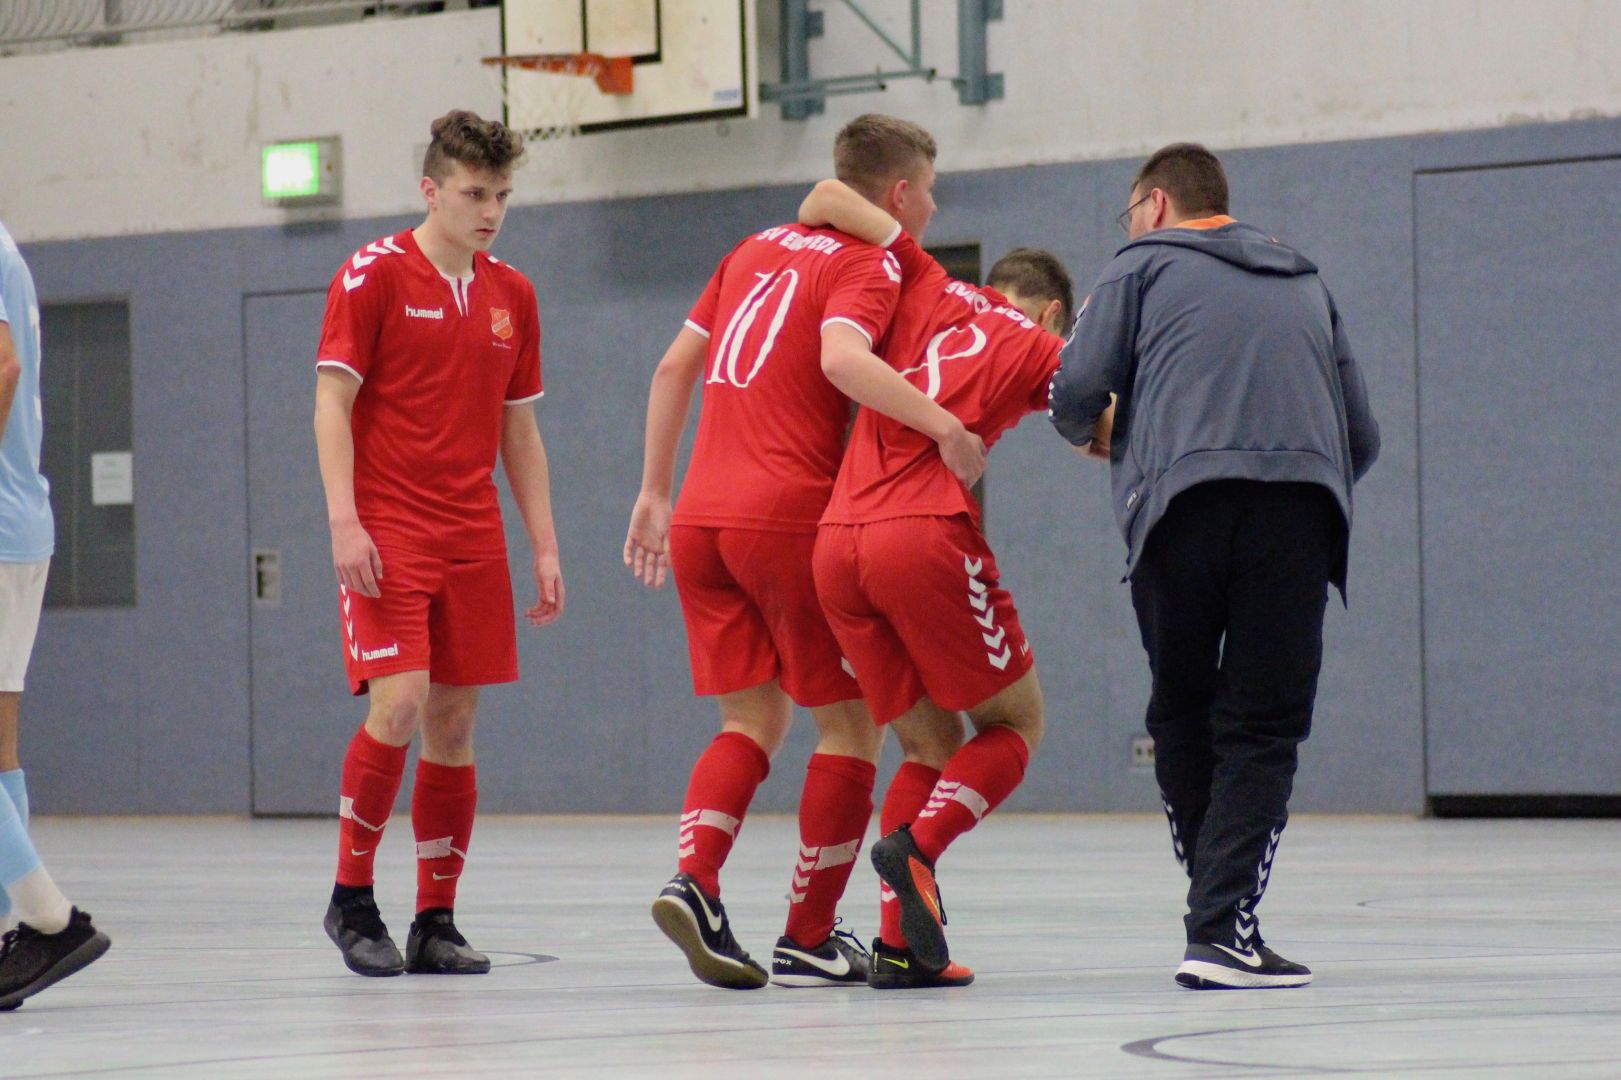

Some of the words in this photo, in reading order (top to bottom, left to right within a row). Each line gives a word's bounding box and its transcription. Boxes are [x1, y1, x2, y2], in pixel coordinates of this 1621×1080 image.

[405, 304, 444, 320] hummel
[706, 268, 798, 388] 10
[361, 643, 399, 662] hummel
